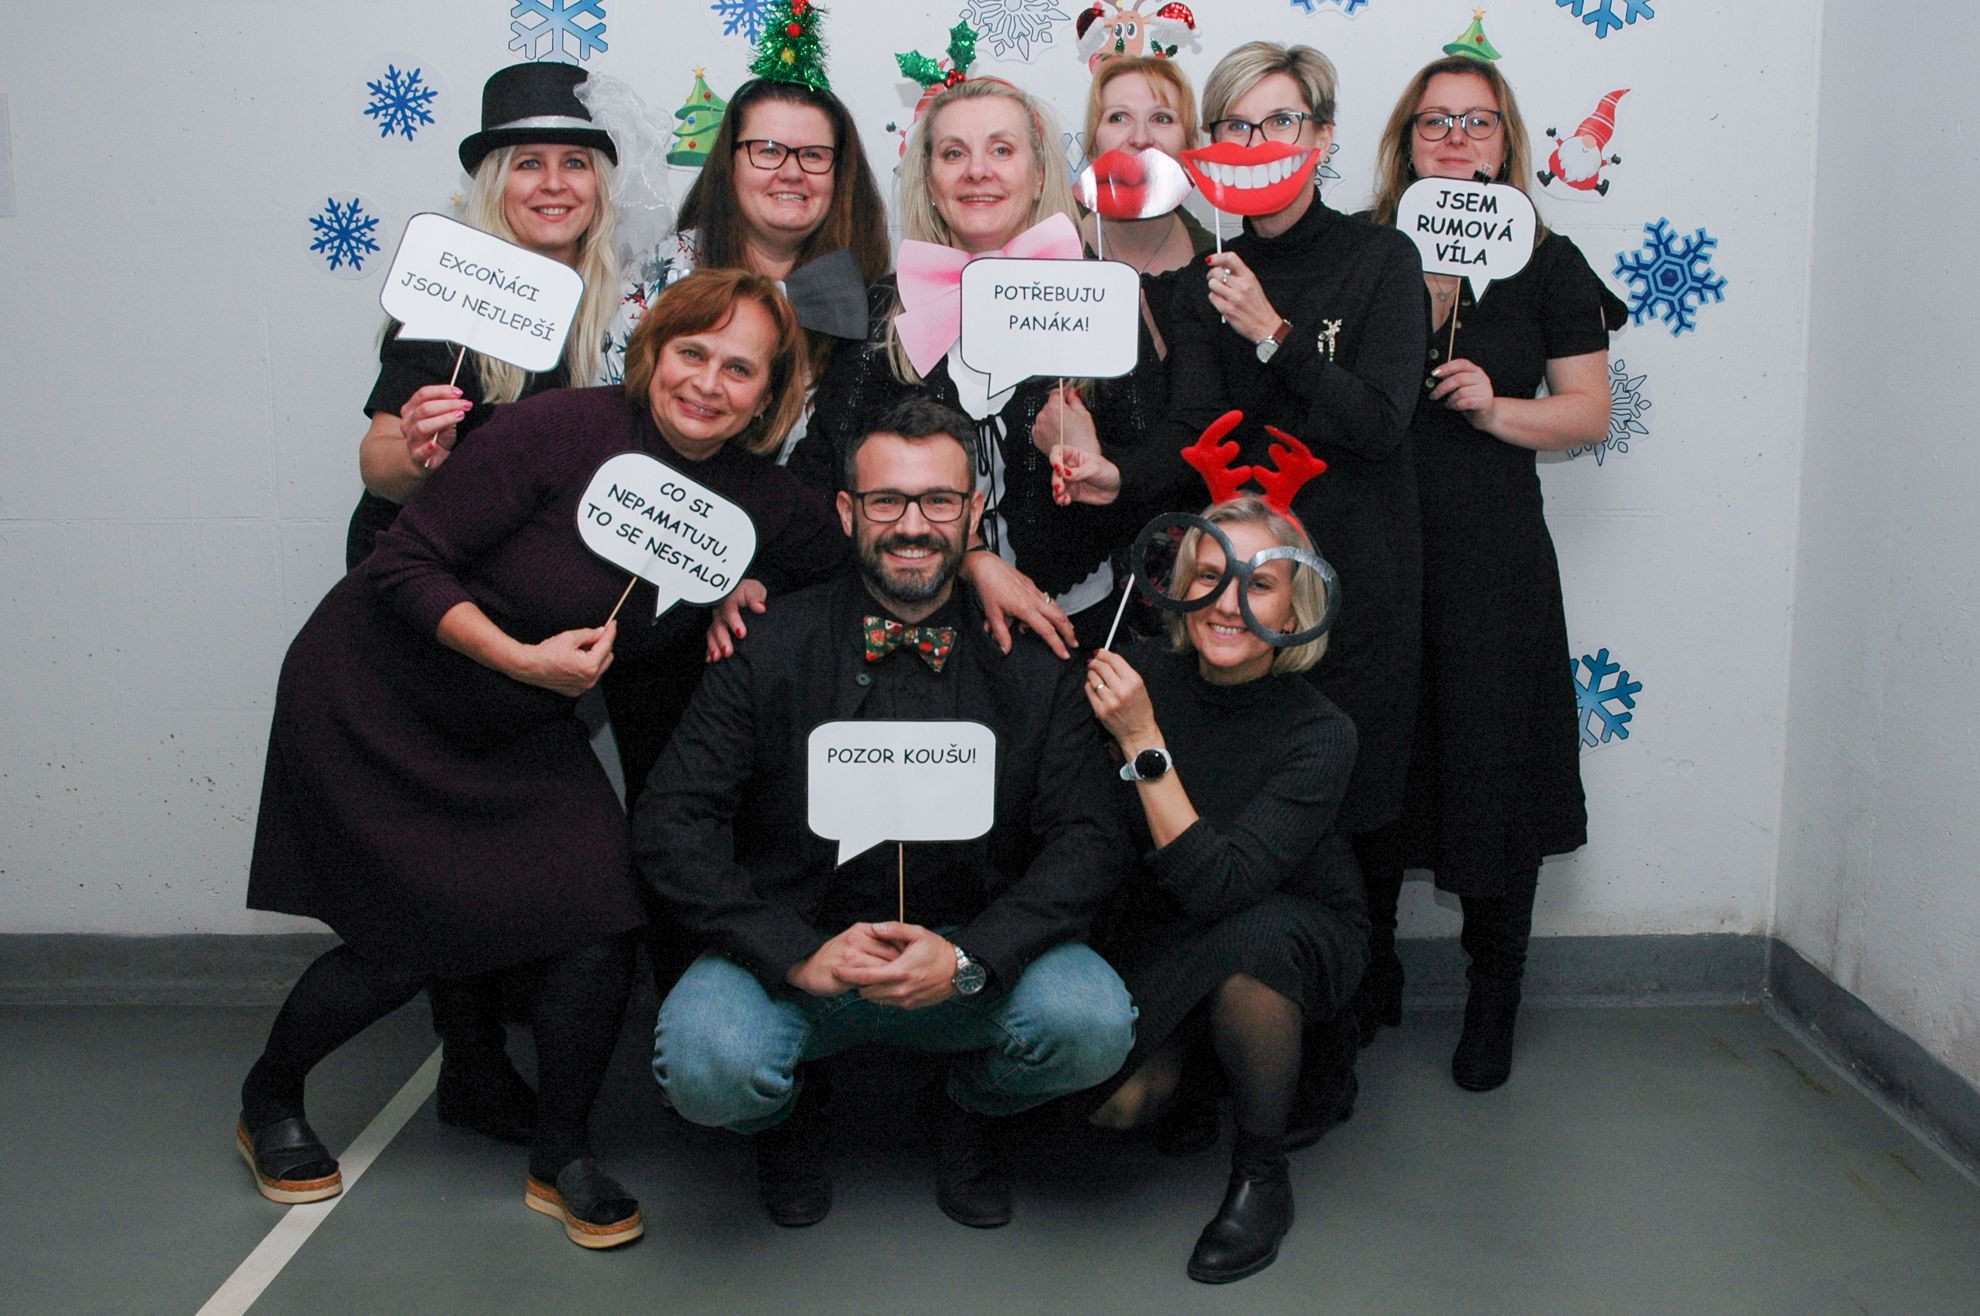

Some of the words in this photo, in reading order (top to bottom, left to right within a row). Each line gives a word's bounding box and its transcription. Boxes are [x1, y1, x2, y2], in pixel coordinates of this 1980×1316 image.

[1436, 190, 1498, 214] JSEM
[1417, 214, 1514, 242] RUMOVÁ
[1436, 239, 1488, 266] VÍLA
[439, 251, 540, 302] EXCOŇÁCI
[994, 281, 1106, 303] POTŘEBUJU
[401, 271, 457, 302] JSOU
[461, 294, 556, 342] NEJLEPŠÍ
[1009, 311, 1089, 332] PANÁKA!
[660, 482, 687, 503] CO
[689, 498, 714, 519] SI
[607, 483, 728, 564] NEPAMATUJU,
[586, 502, 612, 527] TO
[616, 523, 644, 545] SE
[644, 536, 731, 592] NESTALO!
[827, 747, 895, 764] POZOR
[903, 743, 977, 765] KOUŠU!
